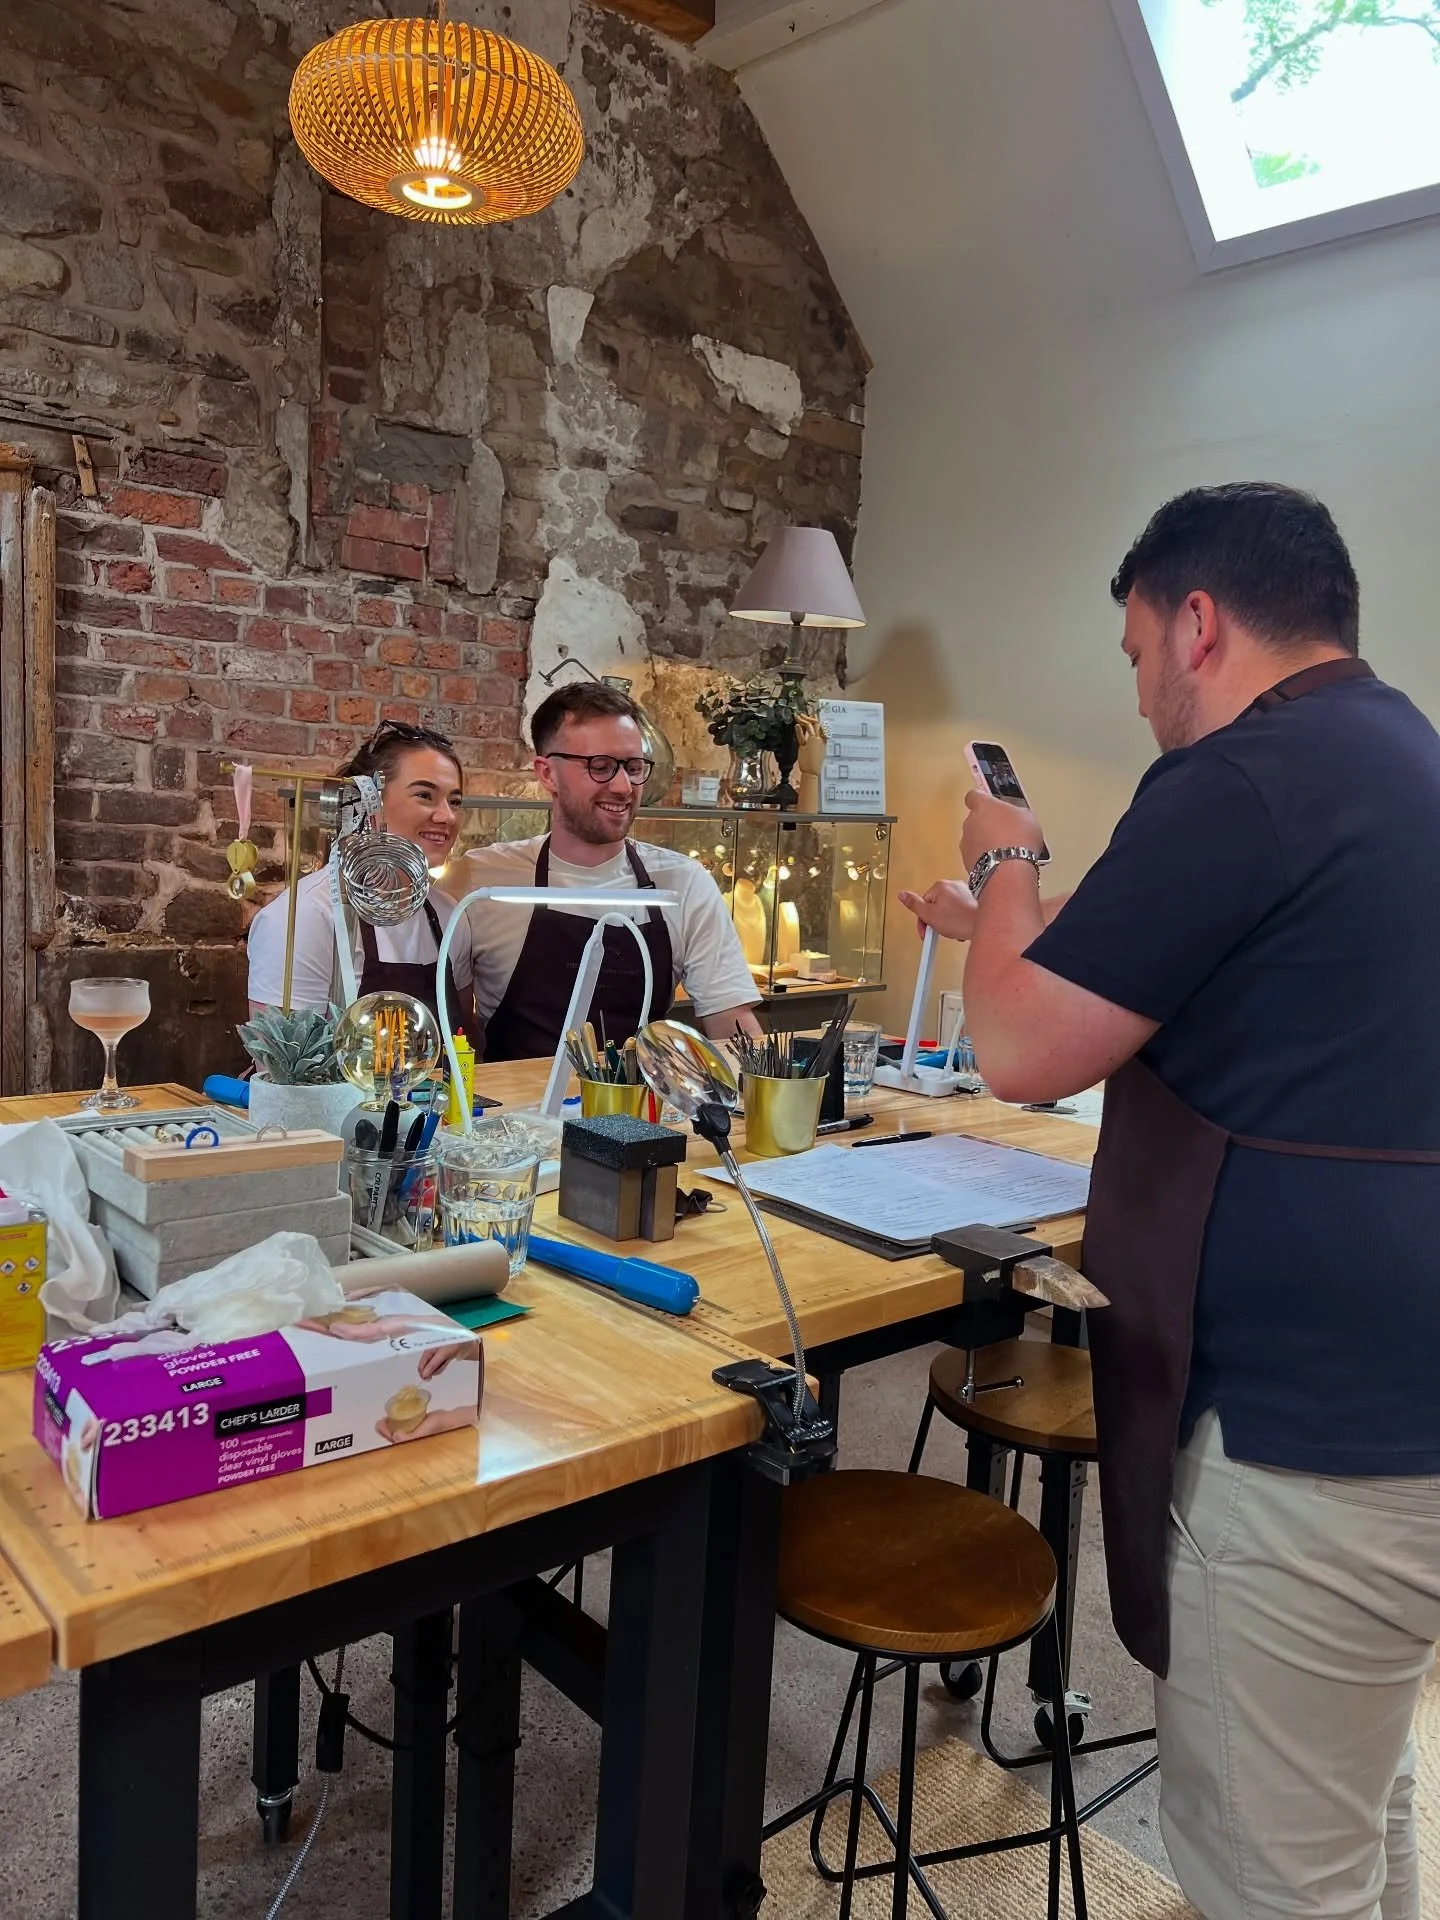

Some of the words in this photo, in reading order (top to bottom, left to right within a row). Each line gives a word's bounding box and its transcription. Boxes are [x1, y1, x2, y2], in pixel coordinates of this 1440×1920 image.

[831, 705, 847, 714] GIA
[163, 1350, 217, 1370] gloves
[168, 1357, 228, 1377] POWDER
[227, 1348, 262, 1363] FREE
[182, 1377, 224, 1393] LARGE
[103, 1402, 210, 1448] 233413
[220, 1411, 258, 1429] CHEF'S
[259, 1403, 301, 1421] LARDER
[218, 1441, 274, 1462] disposable
[219, 1437, 240, 1450] 100
[316, 1437, 352, 1453] LARGE
[217, 1460, 244, 1473] clear
[245, 1452, 270, 1466] vinyl
[270, 1447, 303, 1463] gloves
[217, 1468, 255, 1485] POWDER
[255, 1462, 277, 1475] FREE
